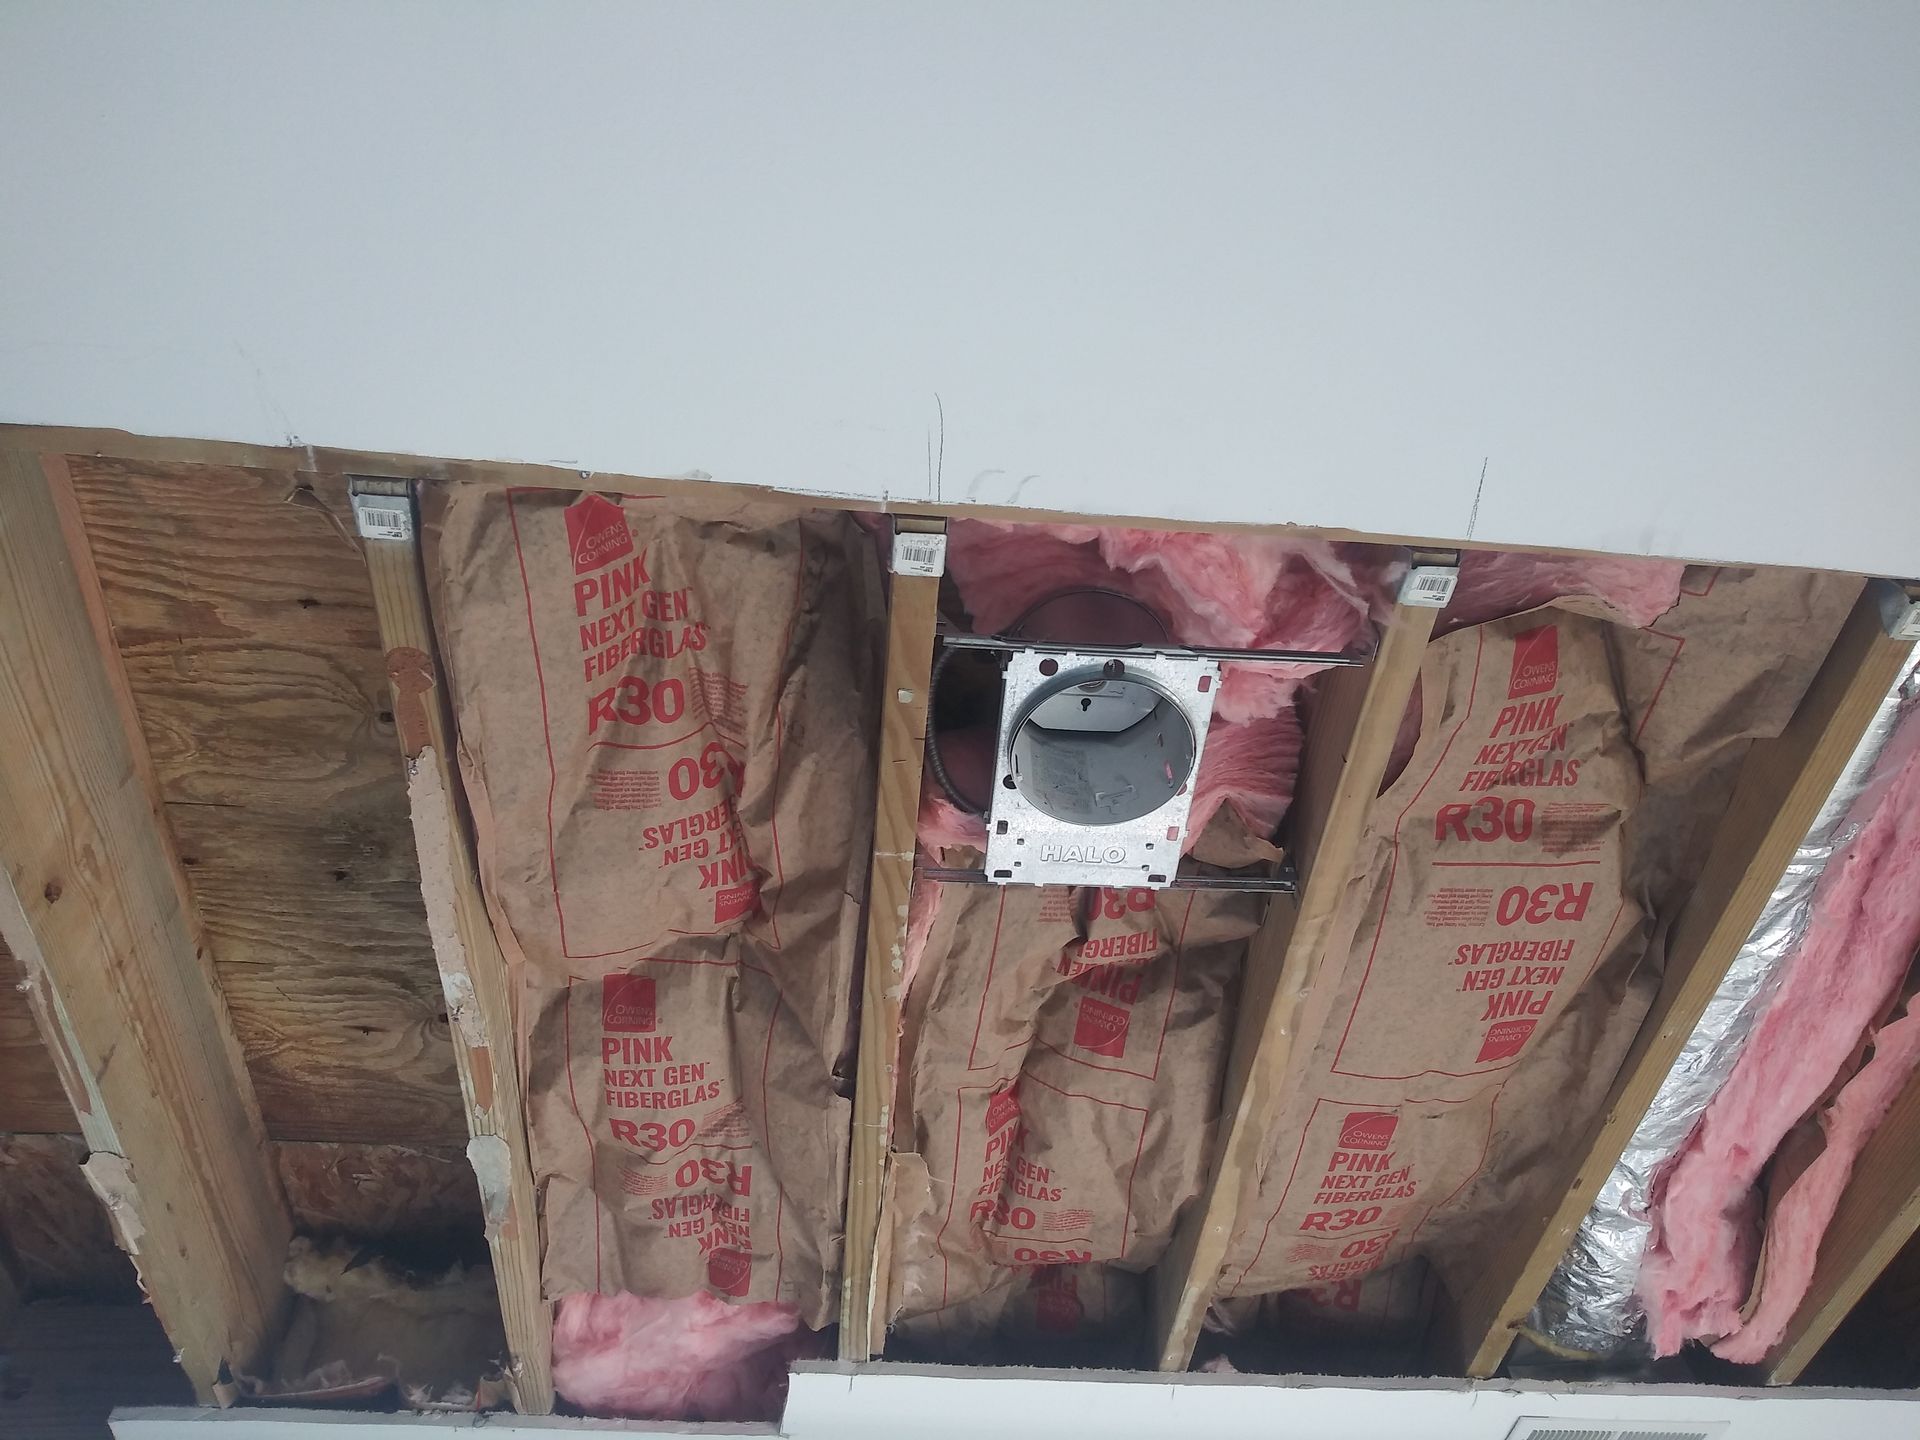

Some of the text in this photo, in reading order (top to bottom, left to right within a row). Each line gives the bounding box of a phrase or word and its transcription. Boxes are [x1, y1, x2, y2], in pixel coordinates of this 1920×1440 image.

[585, 521, 624, 550] OWENS
[578, 535, 628, 565] CORNING
[574, 548, 650, 617] PINK
[580, 588, 690, 651] NEXT GEN
[584, 624, 707, 683] FIBERGLAS
[1513, 673, 1554, 690] CORNING
[1522, 661, 1556, 676] OWENS
[588, 675, 686, 736] R30
[1489, 694, 1565, 739] PINK
[1434, 796, 1536, 843] R30
[664, 838, 709, 866] GEN
[1040, 844, 1126, 864] HALO
[1496, 882, 1594, 926] R30
[1454, 939, 1576, 965] FIBERGLAS
[1462, 966, 1565, 991] NEXT GEN
[615, 1004, 655, 1016] OWENS
[1480, 990, 1554, 1021] PINK
[606, 1014, 654, 1026] CORNING
[1489, 1025, 1532, 1036] CORNING
[602, 1036, 674, 1065] PINK
[1488, 1033, 1522, 1043] OWENS
[604, 1062, 706, 1088] NEXT GEN
[605, 1079, 721, 1110] FIBERGLAS
[609, 1117, 696, 1152] R30
[1342, 1135, 1387, 1147] CORNING
[1353, 1130, 1390, 1140] OWENS
[1016, 1156, 1050, 1184] GEN
[1328, 1151, 1396, 1173] PINK
[675, 1158, 752, 1197] R30
[1320, 1165, 1411, 1190] NEXT GEN
[1312, 1180, 1417, 1205] FIBERGLAS
[668, 1217, 705, 1239] GEN
[1299, 1205, 1383, 1232] R30
